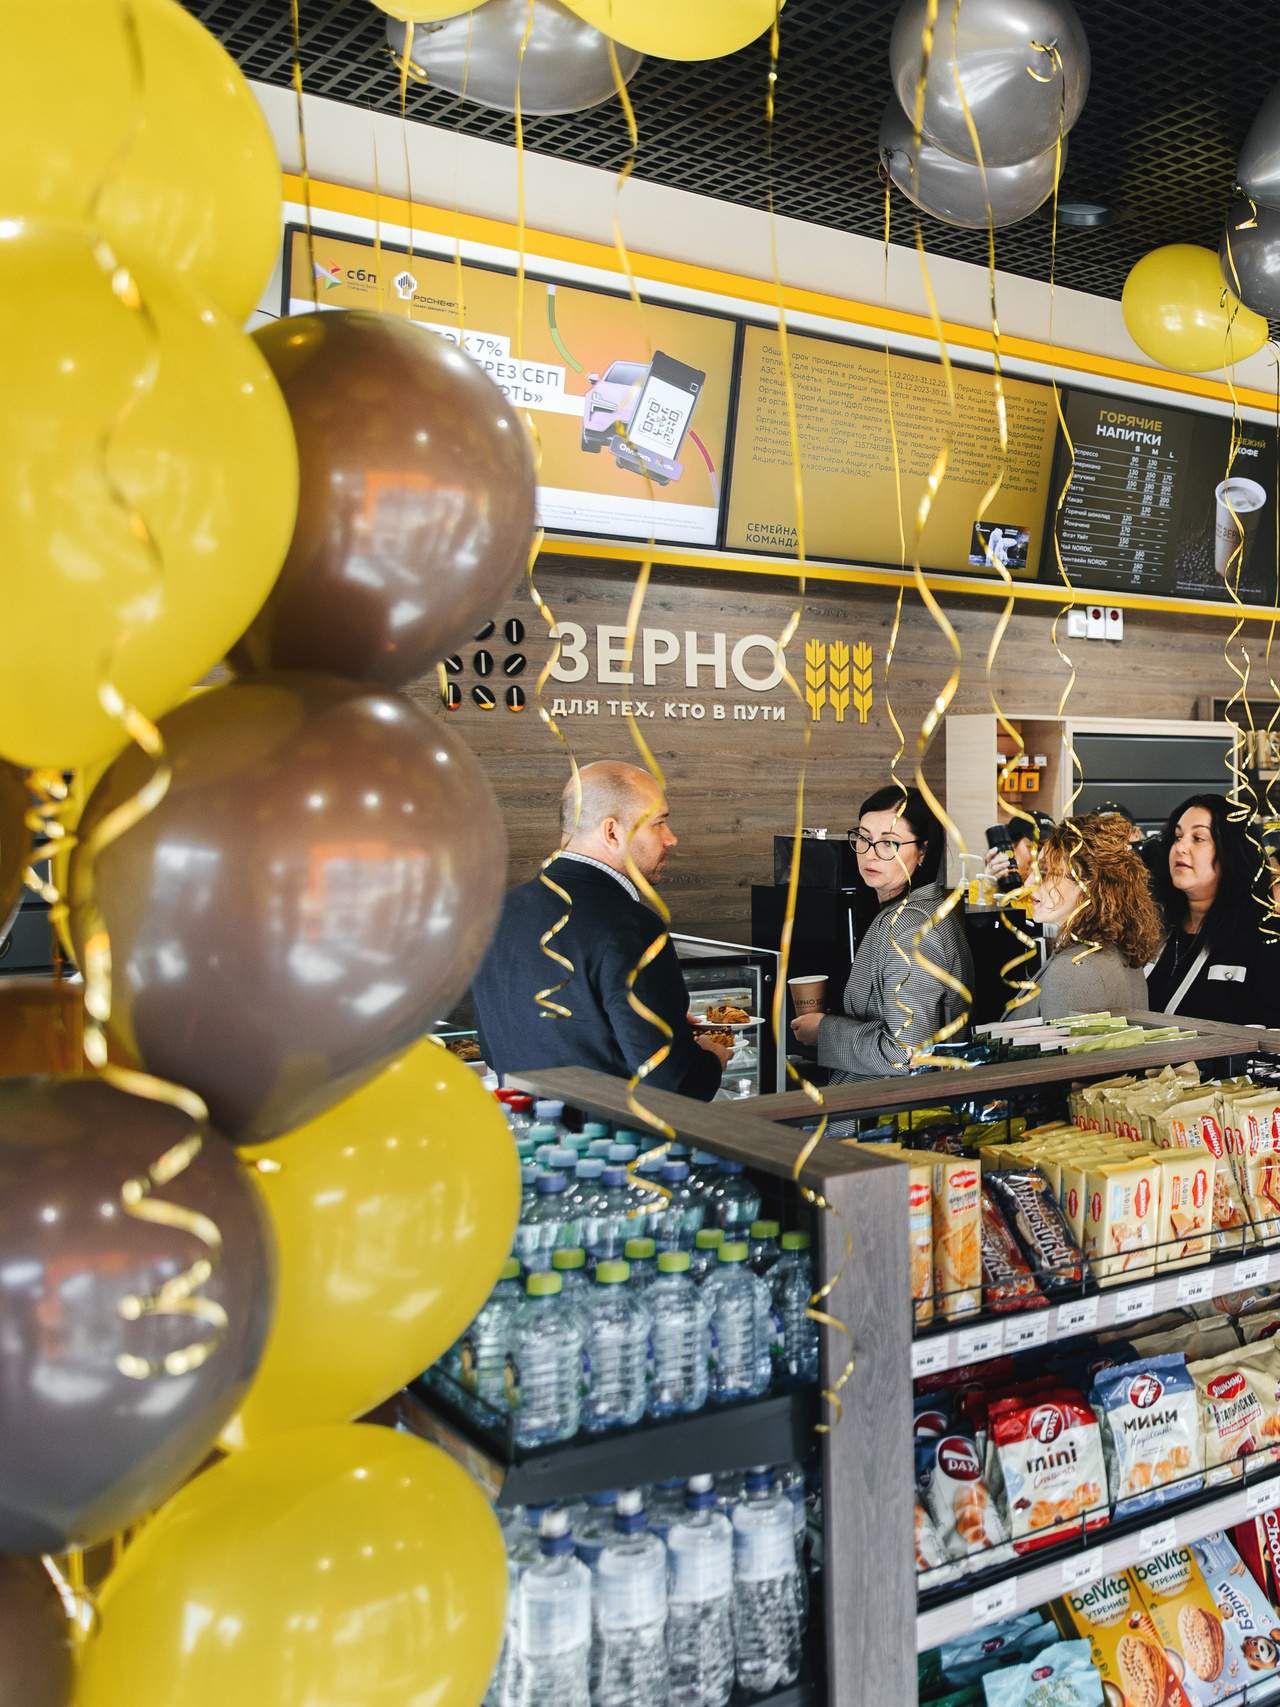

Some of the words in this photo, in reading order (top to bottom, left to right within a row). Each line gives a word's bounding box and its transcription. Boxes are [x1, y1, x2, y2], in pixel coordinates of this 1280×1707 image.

[346, 266, 377, 284] сбп
[475, 338, 503, 357] 7%
[521, 366, 559, 388] СБП
[791, 352, 808, 363] срок
[811, 356, 854, 371] проведения
[957, 383, 981, 395] Период
[796, 381, 821, 393] Указан
[829, 389, 854, 400] размер
[906, 403, 925, 413] приза
[932, 407, 952, 416] после
[811, 366, 838, 378] участия
[1032, 407, 1047, 416] Сети
[826, 377, 867, 393] Розыгрыши
[956, 403, 974, 411] после
[840, 399, 862, 410] НДФЛ
[896, 410, 932, 422] налогового
[1098, 409, 1162, 432] ГОРЯЧИЕ
[862, 424, 881, 432] месте
[1095, 423, 1162, 446] НАПИТКИ
[1134, 445, 1140, 453] S
[1151, 448, 1158, 456] M
[745, 533, 800, 548] КОМАНДА
[747, 522, 798, 537] СЕМЕЙНА
[547, 620, 787, 692] ЗЕРНО
[550, 698, 599, 718] ДЛЯ
[606, 700, 655, 719] ТЕХ,
[663, 702, 706, 720] КТО
[715, 704, 727, 720] В
[733, 705, 787, 722] ПУТИ
[1123, 1187, 1131, 1216] ВАФЛИ
[1137, 1180, 1148, 1216] Яшкино
[1195, 1172, 1205, 1207] Яшкино
[1132, 1378, 1152, 1407] 7
[1212, 1373, 1243, 1398] Яшкино
[1031, 1409, 1054, 1443] 7
[1046, 1411, 1060, 1439] DAYS
[1026, 1441, 1078, 1474] mini
[1134, 1548, 1192, 1582] belVita
[1149, 1567, 1190, 1589] УТРЕННЕЕ
[1068, 1576, 1132, 1613] belVita
[1086, 1596, 1129, 1619] УТРЕННЕЕ
[1217, 1581, 1255, 1631] Барни
